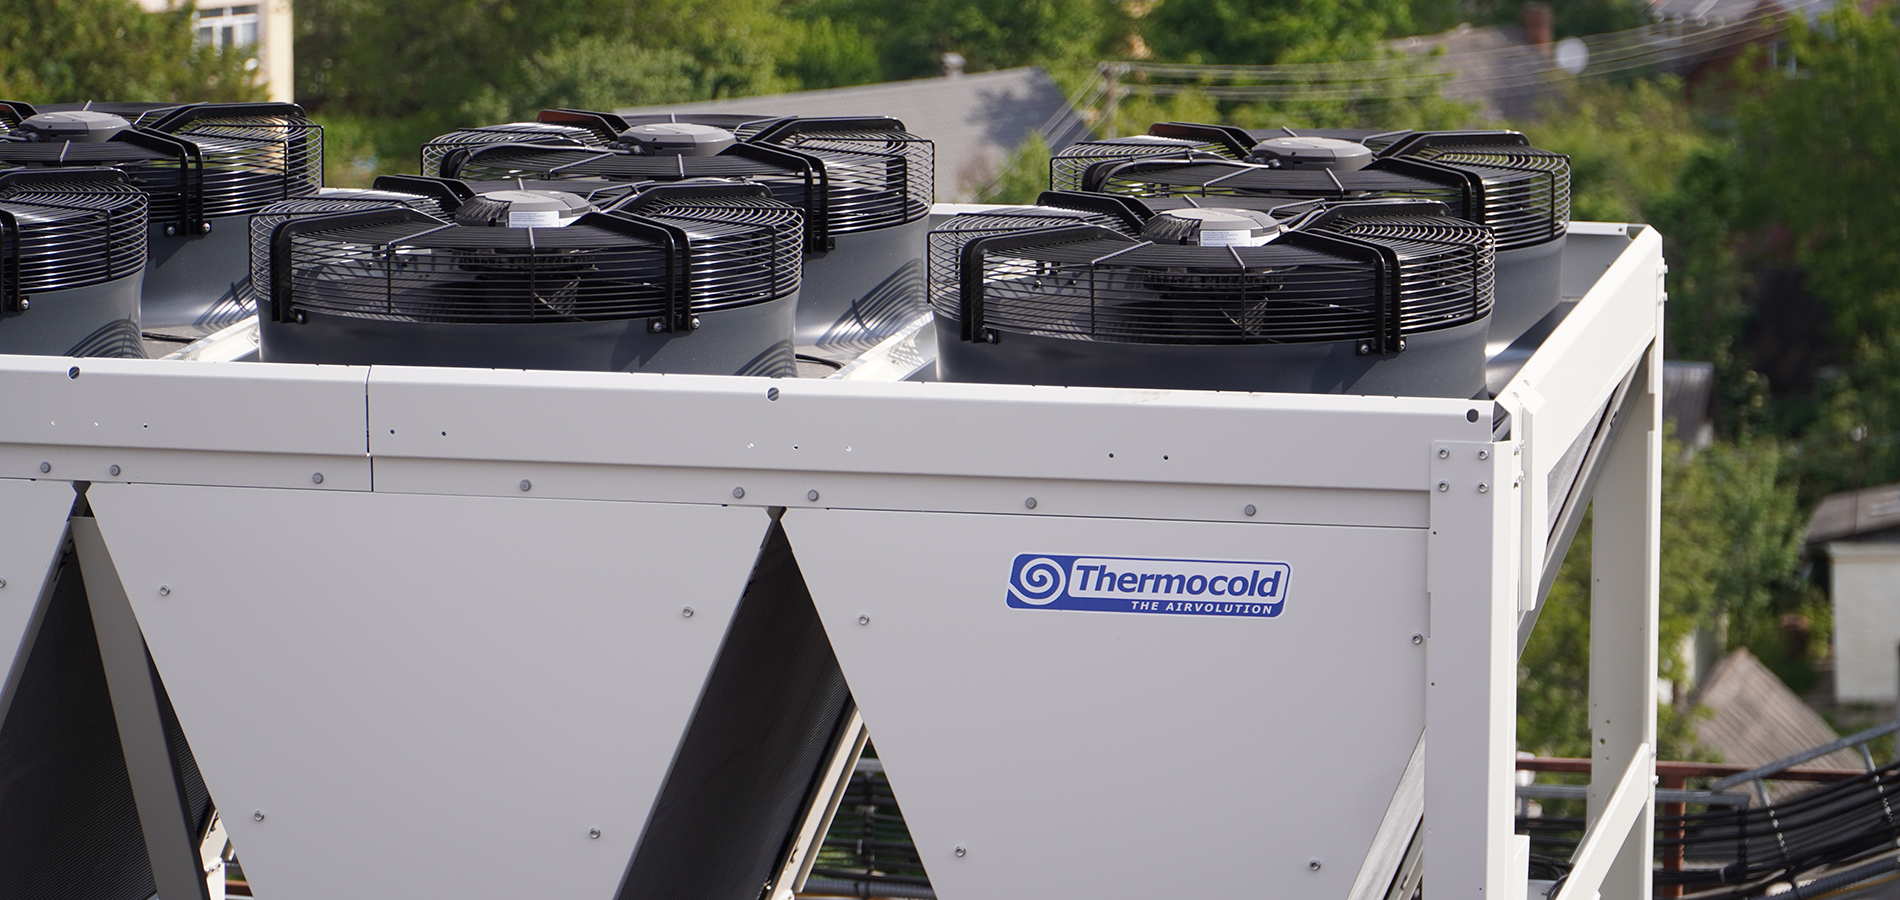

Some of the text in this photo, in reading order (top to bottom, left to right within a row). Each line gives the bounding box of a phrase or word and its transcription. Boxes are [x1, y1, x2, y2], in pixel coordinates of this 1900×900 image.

[1076, 565, 1282, 597] Thermocold
[1131, 600, 1273, 614] THE AIRVOLUTION
